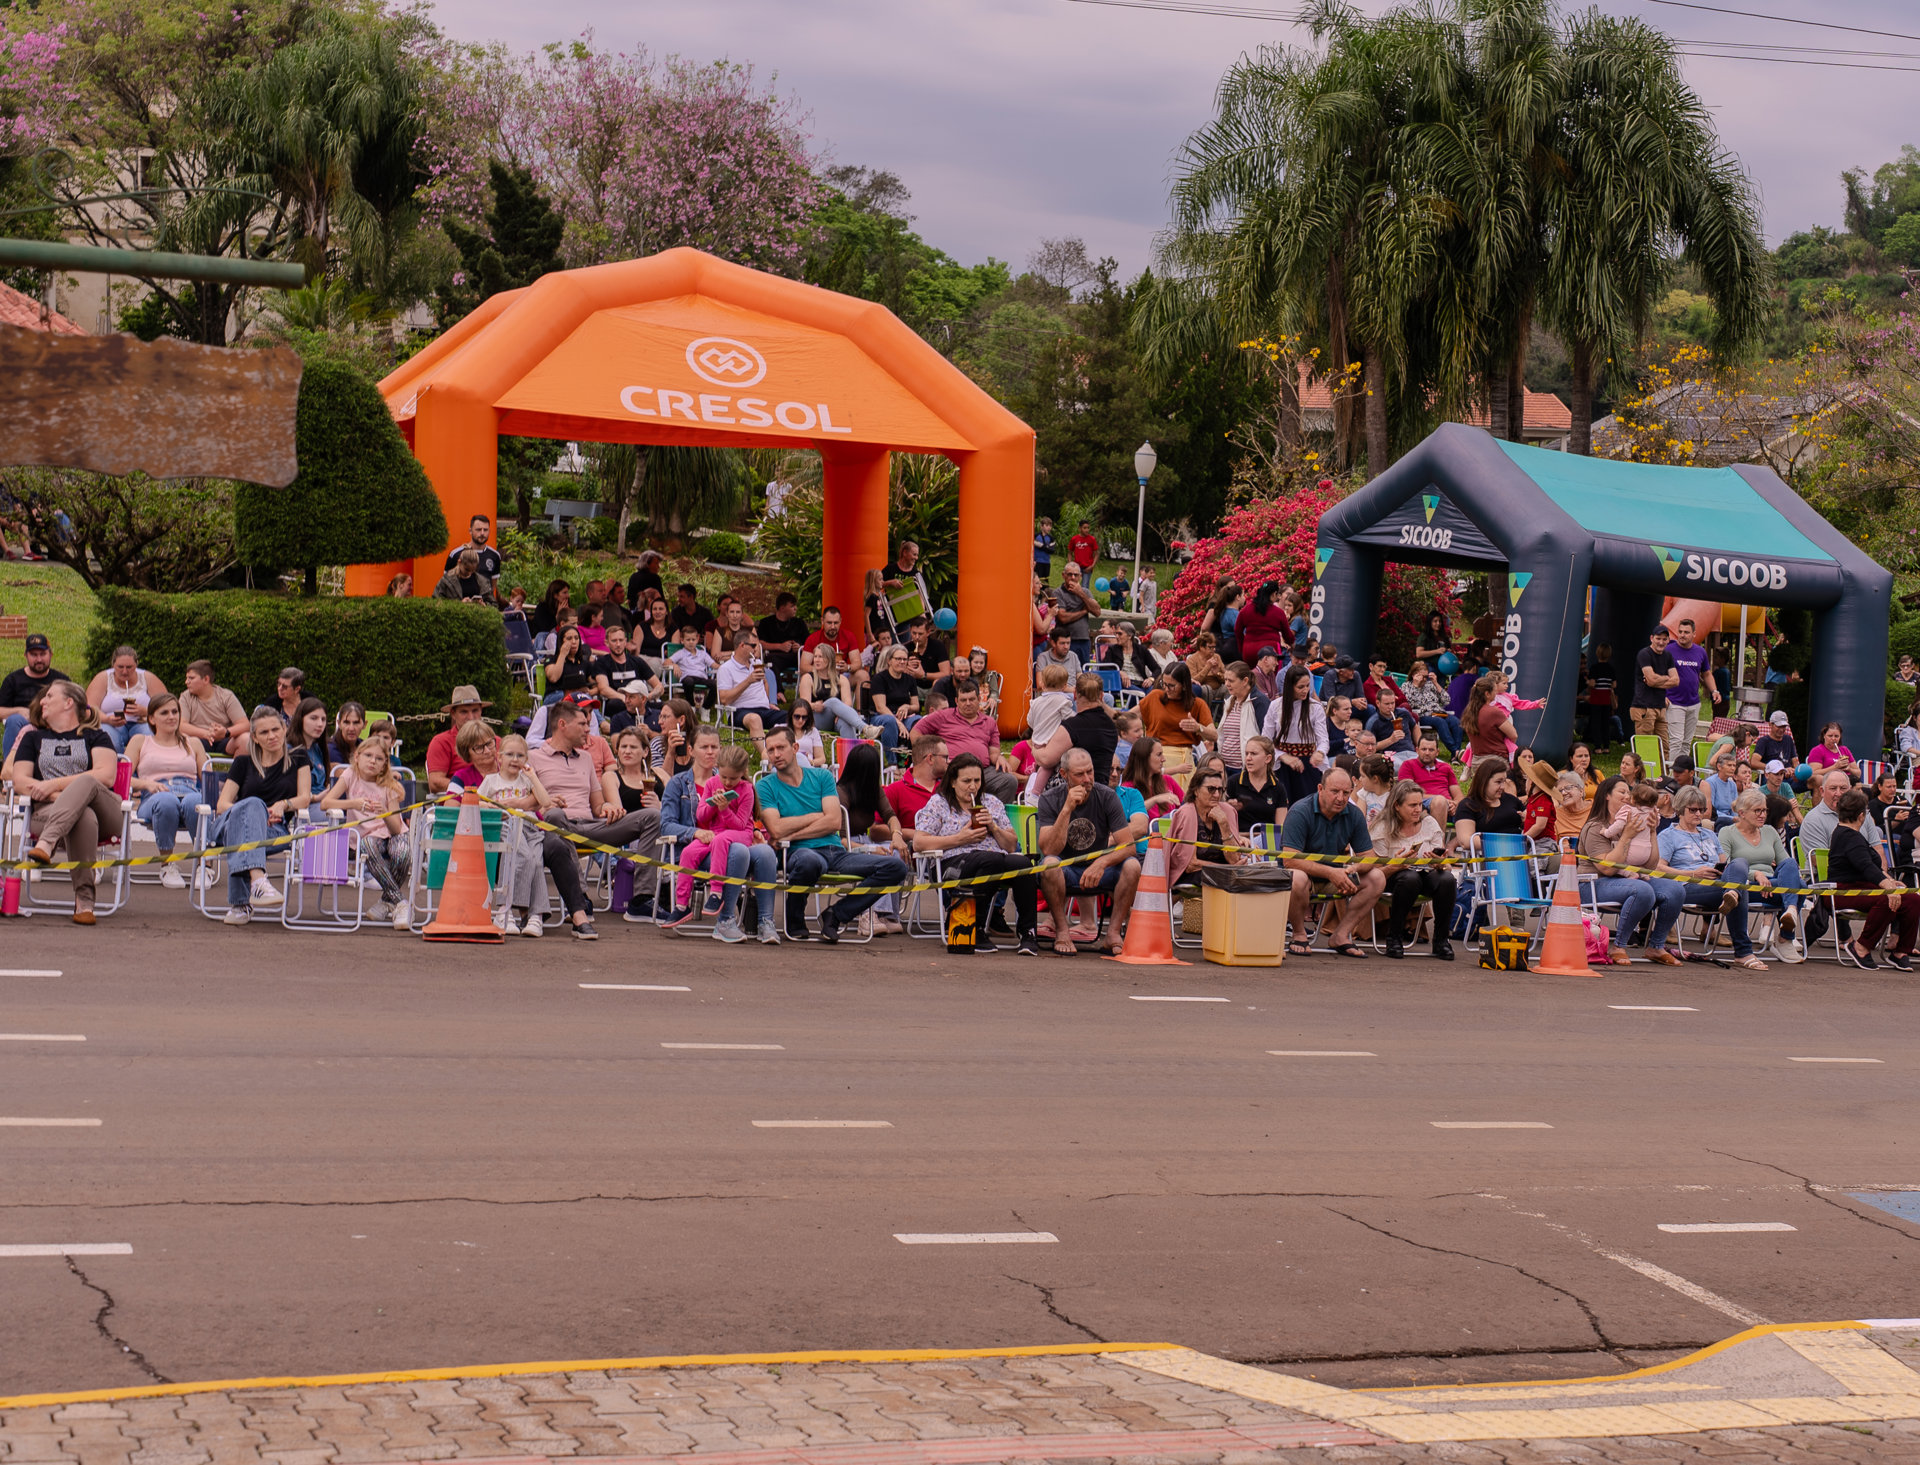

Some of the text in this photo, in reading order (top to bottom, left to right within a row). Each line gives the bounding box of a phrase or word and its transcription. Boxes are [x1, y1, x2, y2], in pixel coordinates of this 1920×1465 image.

[620, 385, 852, 433] CRESOL
[1399, 524, 1453, 549] SICOOB
[1686, 554, 1787, 590] SICOOB
